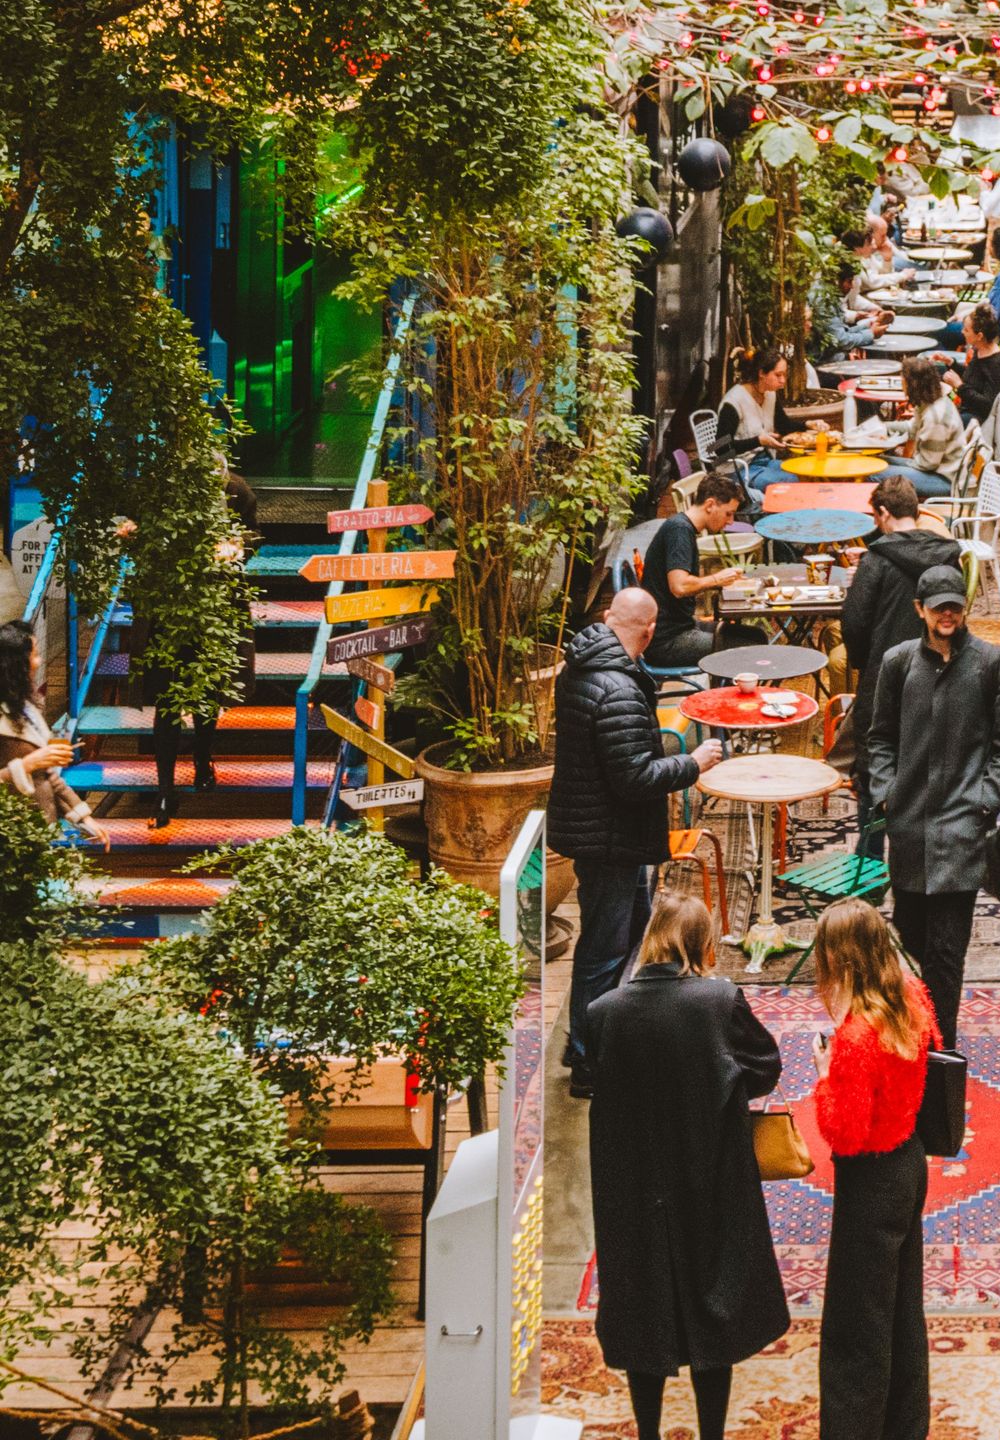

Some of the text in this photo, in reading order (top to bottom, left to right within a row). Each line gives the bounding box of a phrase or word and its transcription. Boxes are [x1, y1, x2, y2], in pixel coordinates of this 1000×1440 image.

[22, 541, 40, 551] FOR
[22, 565, 32, 574] AT
[318, 556, 415, 579] CAFFETTERIA
[332, 596, 381, 618] PIZZERIA
[334, 626, 408, 662] COCKTAIL BAR
[356, 785, 407, 803] TOILETTES
